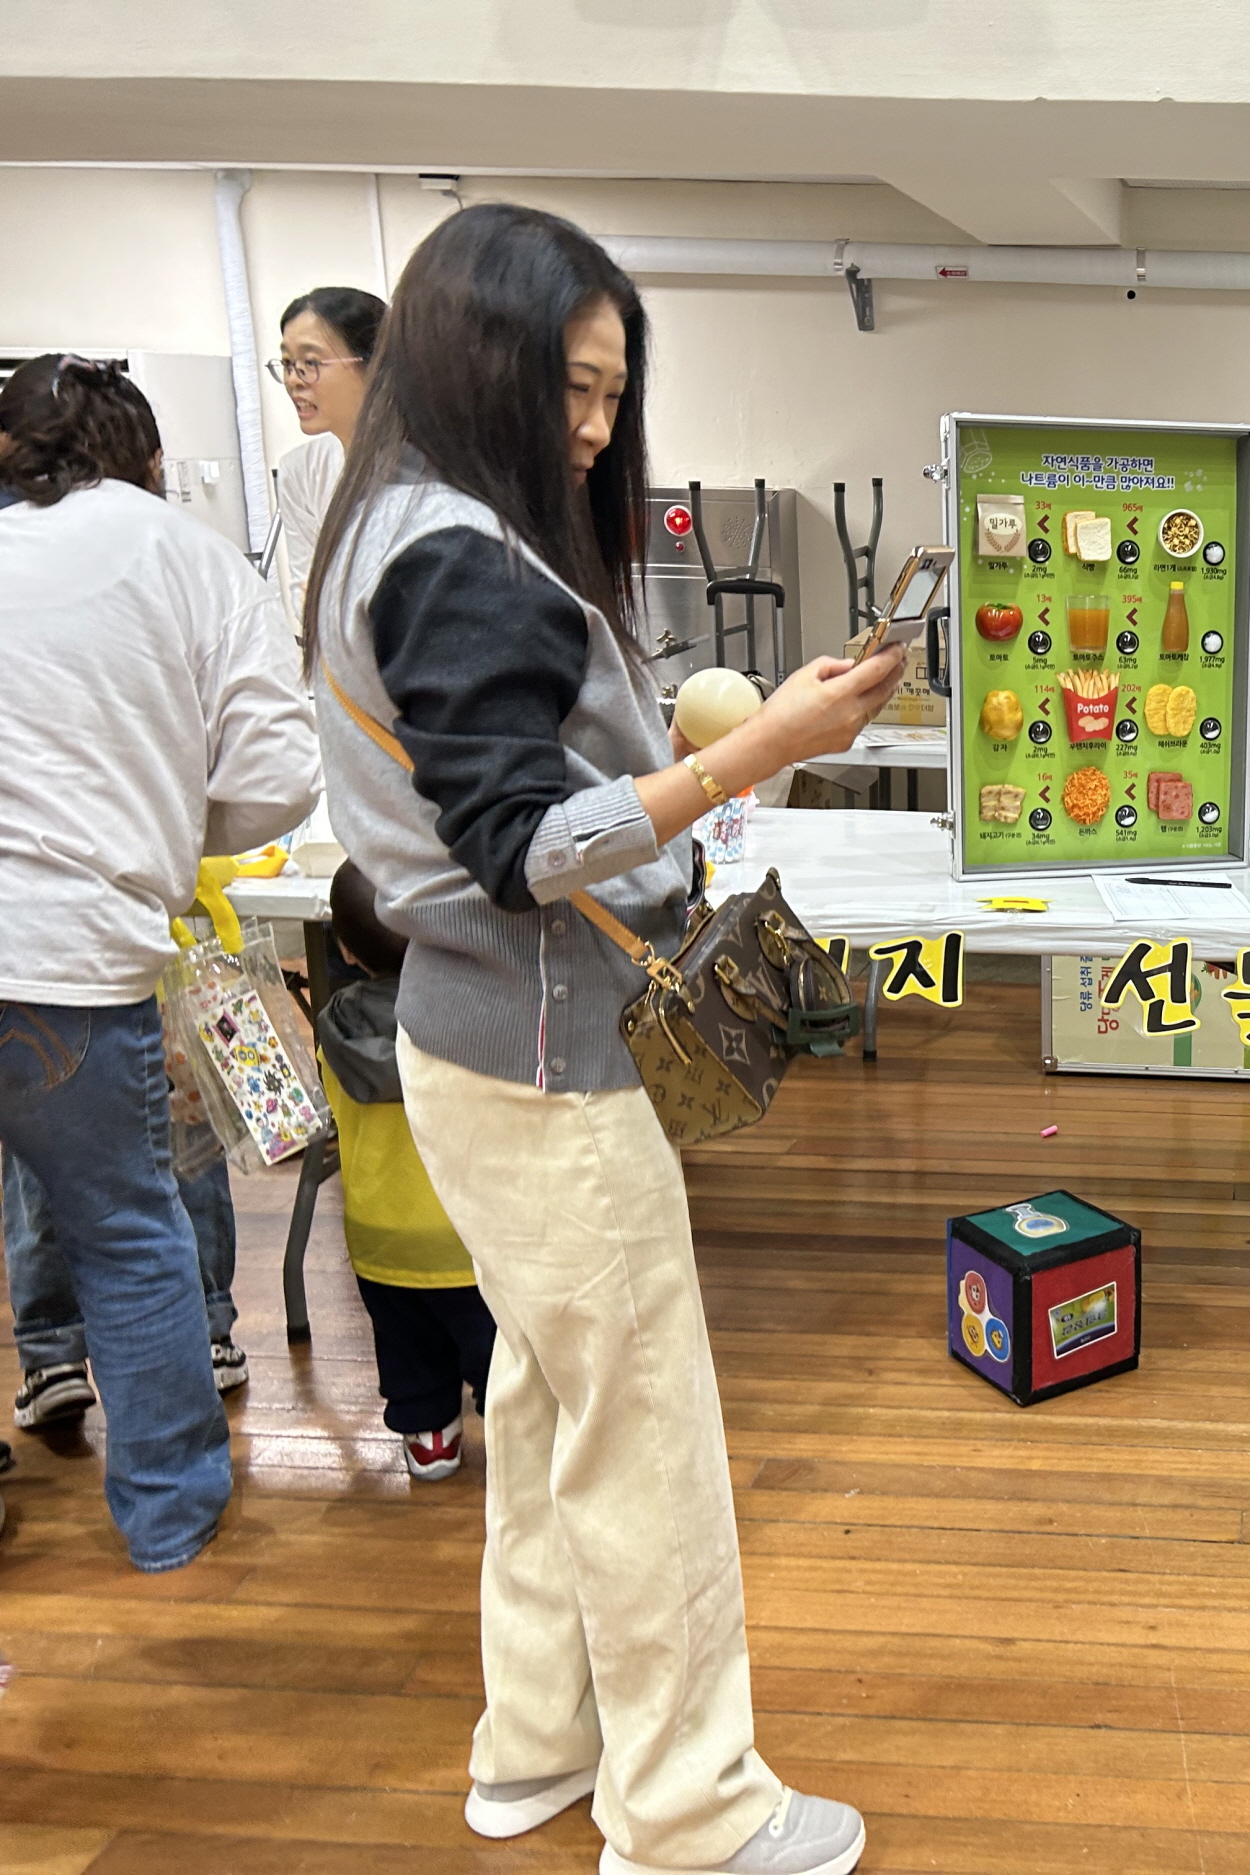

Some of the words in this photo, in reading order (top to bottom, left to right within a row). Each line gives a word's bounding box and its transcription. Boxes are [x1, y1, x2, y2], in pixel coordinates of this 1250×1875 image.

[1042, 454, 1103, 472] 자연식품을
[1106, 457, 1154, 473] 가공하면
[1021, 473, 1070, 488] 나트륨이
[1073, 474, 1117, 489] 이~만큼
[1120, 475, 1175, 490] 많아져요!!
[989, 518, 1017, 529] 밀가루
[988, 561, 1009, 571] 밀가루
[1032, 565, 1048, 574] 2mg
[1082, 563, 1095, 572] 식빵
[1118, 566, 1138, 574] 66mg
[1153, 564, 1177, 572] 라면1개
[1201, 567, 1227, 576] 1,930mg
[989, 654, 1009, 662] 토마토
[1032, 657, 1048, 665] 5mg
[1072, 653, 1105, 662] 토마토주스
[1118, 656, 1137, 664] 63mg
[1077, 703, 1110, 713] Potato
[1033, 746, 1048, 754] 2mg
[1116, 744, 1138, 753] 227mg
[1199, 742, 1221, 751] 403mg
[1032, 833, 1050, 841] 34mg
[1078, 828, 1098, 837] 돈까스
[1116, 830, 1138, 838] 541mg
[1080, 966, 1093, 988] 섭취
[1080, 990, 1093, 1012] 당류
